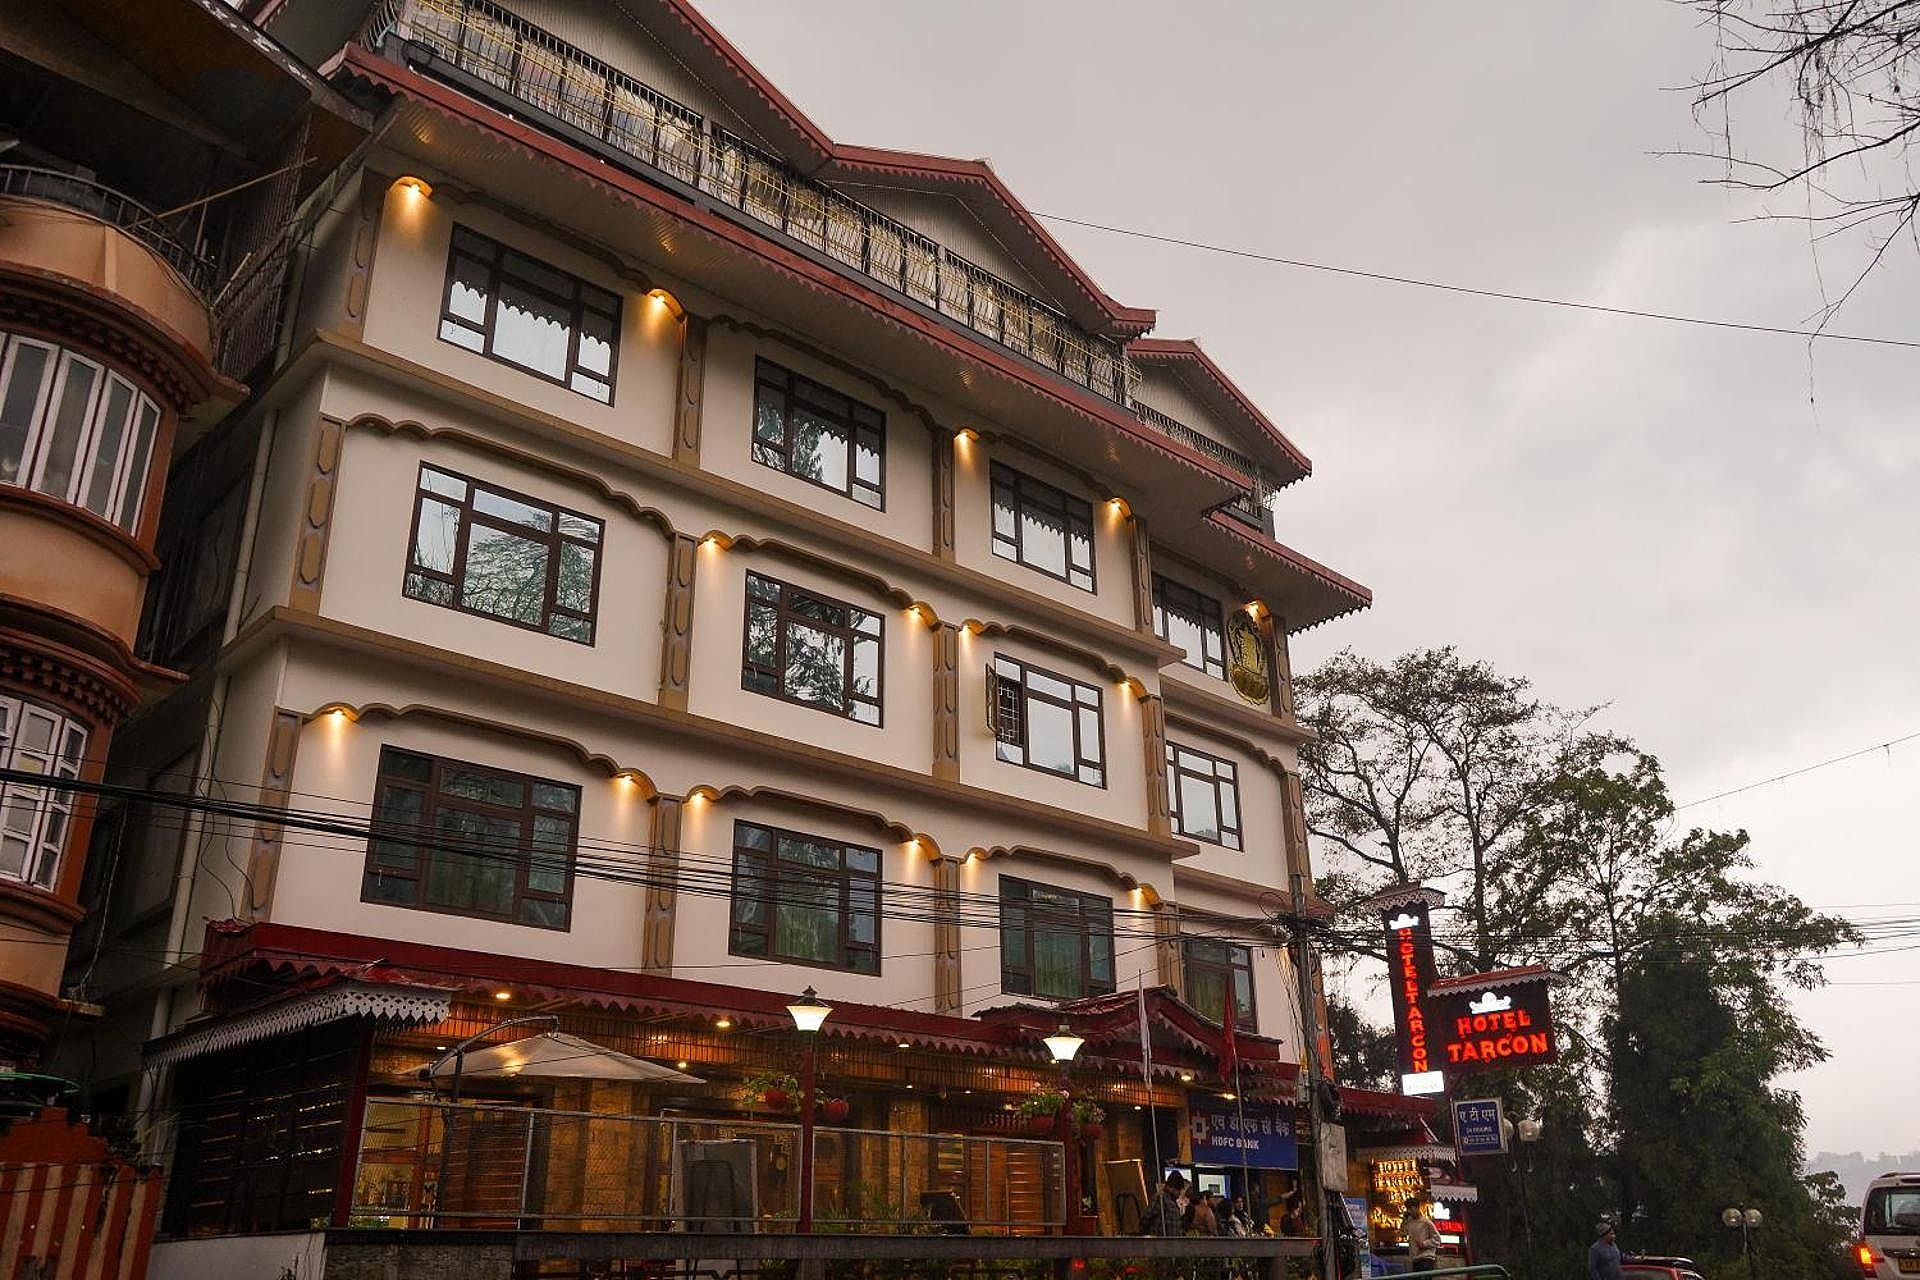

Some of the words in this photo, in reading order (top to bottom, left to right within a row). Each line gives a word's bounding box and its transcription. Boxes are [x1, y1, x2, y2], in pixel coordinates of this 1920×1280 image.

[1456, 1010, 1531, 1035] HOTEL
[1447, 1033, 1548, 1063] TARCON
[1211, 1136, 1235, 1148] HDFC
[1236, 1139, 1259, 1150] BANK
